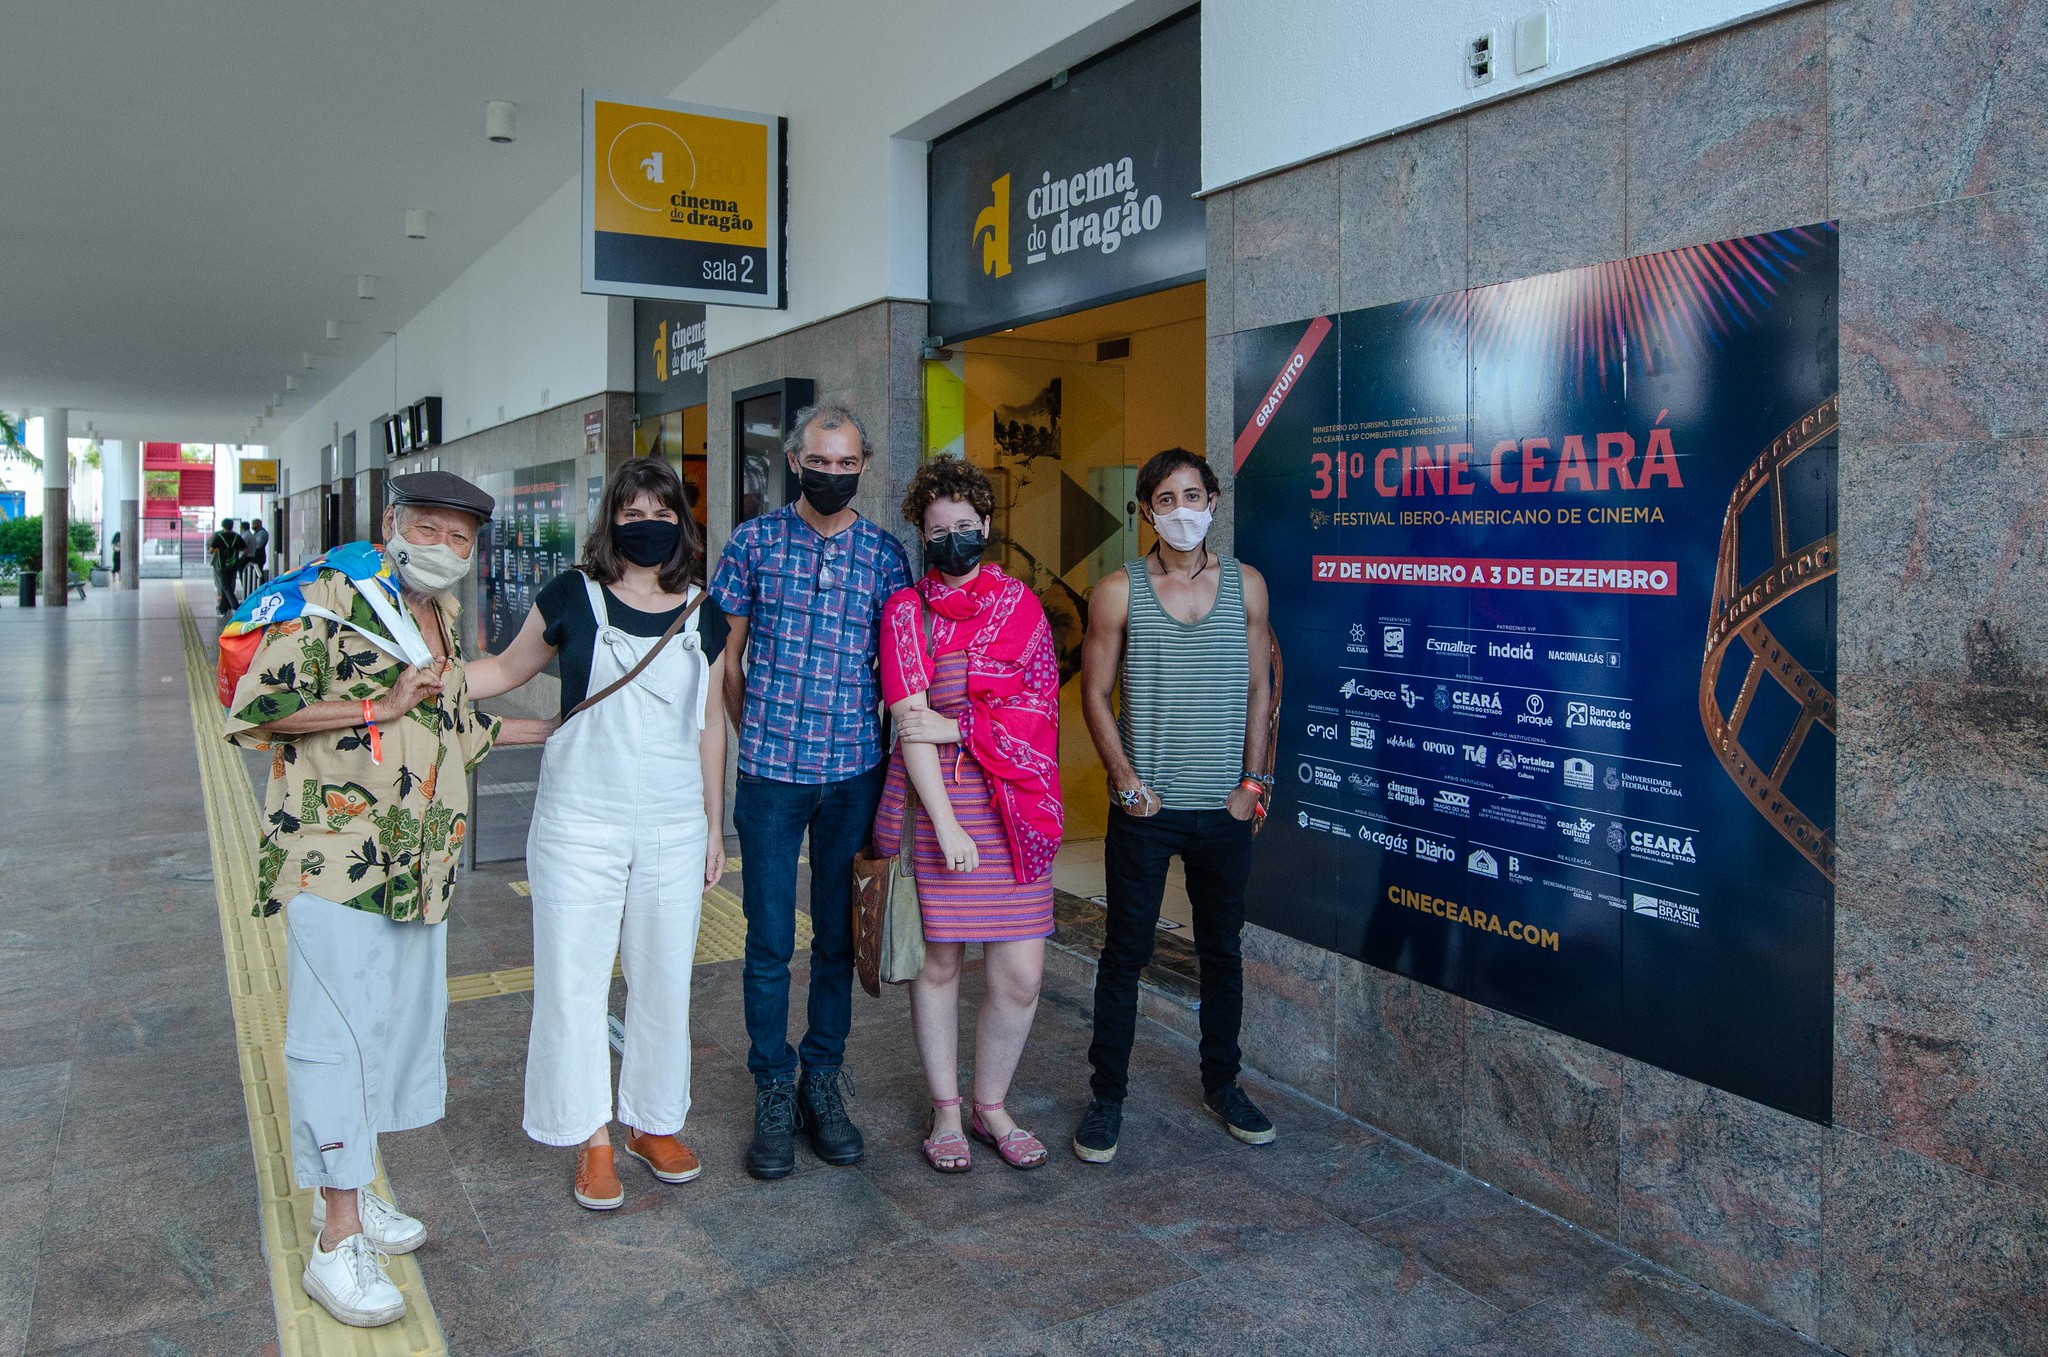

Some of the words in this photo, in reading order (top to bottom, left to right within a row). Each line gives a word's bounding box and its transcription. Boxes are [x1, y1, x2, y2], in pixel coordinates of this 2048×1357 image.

[1027, 157, 1135, 220] cinema
[670, 190, 738, 214] cinema
[670, 208, 684, 219] do
[687, 210, 753, 232] dragão
[1027, 224, 1047, 252] do
[1050, 188, 1162, 255] dragão
[702, 260, 737, 282] sala
[741, 255, 754, 284] 2
[1256, 353, 1304, 427] GRATUITO
[1313, 424, 1347, 434] MINISTÉRIO
[1360, 420, 1390, 430] TURISMO,
[1391, 417, 1434, 427] SECRETARIA
[1436, 416, 1446, 424] DA
[1313, 436, 1322, 444] DO
[1323, 433, 1346, 442] CEARÁ
[1346, 433, 1350, 441] E
[1351, 432, 1359, 441] SP
[1360, 430, 1409, 440] COMBUSTÍVEIS
[1410, 425, 1458, 436] APRESENTAM
[1374, 443, 1475, 497] CINE
[1490, 408, 1684, 494] CEARÁ
[1333, 511, 1395, 526] FESTIVAL
[1399, 509, 1551, 526] IBERO-AMERICANO
[1557, 508, 1581, 524] DE
[1587, 506, 1665, 524] CINEMA
[1318, 562, 1336, 578] 27
[1340, 562, 1361, 579] DE
[1366, 563, 1466, 583] NOVEMBRO
[1471, 566, 1485, 583] A
[1490, 567, 1502, 585] 3
[1507, 567, 1534, 585] DE
[1540, 568, 1668, 590] DEZEMBRO
[1347, 646, 1369, 654] CULTURA
[1427, 638, 1477, 654] Esmaltec
[1549, 650, 1604, 664] NACIONALGÁS
[1356, 685, 1397, 700] Cagece
[1453, 691, 1502, 709] CEARÁ
[1517, 713, 1553, 727] piraquê
[1590, 705, 1616, 718] Banco
[1619, 709, 1631, 720] do
[1351, 720, 1370, 728] CANAL
[1590, 716, 1631, 730] Nordeste
[1307, 723, 1338, 740] enel
[1508, 734, 1546, 743] INSTITUCIONAL
[1518, 754, 1554, 768] Fortaleza
[1523, 765, 1549, 773] PREFEITURA
[1315, 771, 1341, 782] DRAGÃO
[1518, 772, 1534, 780] Cultura
[1388, 781, 1418, 795] cinema
[1622, 781, 1649, 792] FEDERAL
[1388, 790, 1394, 798] do
[1395, 791, 1425, 806] dragão
[1433, 803, 1450, 811] DRAGÃO
[1368, 811, 1388, 820] CULTURAL
[1557, 821, 1577, 831] ceará
[1372, 832, 1408, 850] cegás
[1563, 829, 1590, 840] cultura
[1416, 837, 1455, 862] Diário
[1631, 831, 1696, 857] CEARÁ
[1558, 854, 1591, 866] REALIZAÇÃO
[1631, 845, 1660, 856] GOVERNO
[1671, 854, 1696, 863] ESTADO
[1509, 856, 1519, 872] B
[1543, 880, 1566, 890] SECRETARIA
[1659, 899, 1678, 909] PÁTRIA
[1679, 904, 1700, 914] AMADA
[1659, 905, 1700, 924] BRASIL
[1388, 885, 1559, 952] CINECEARA.COM
